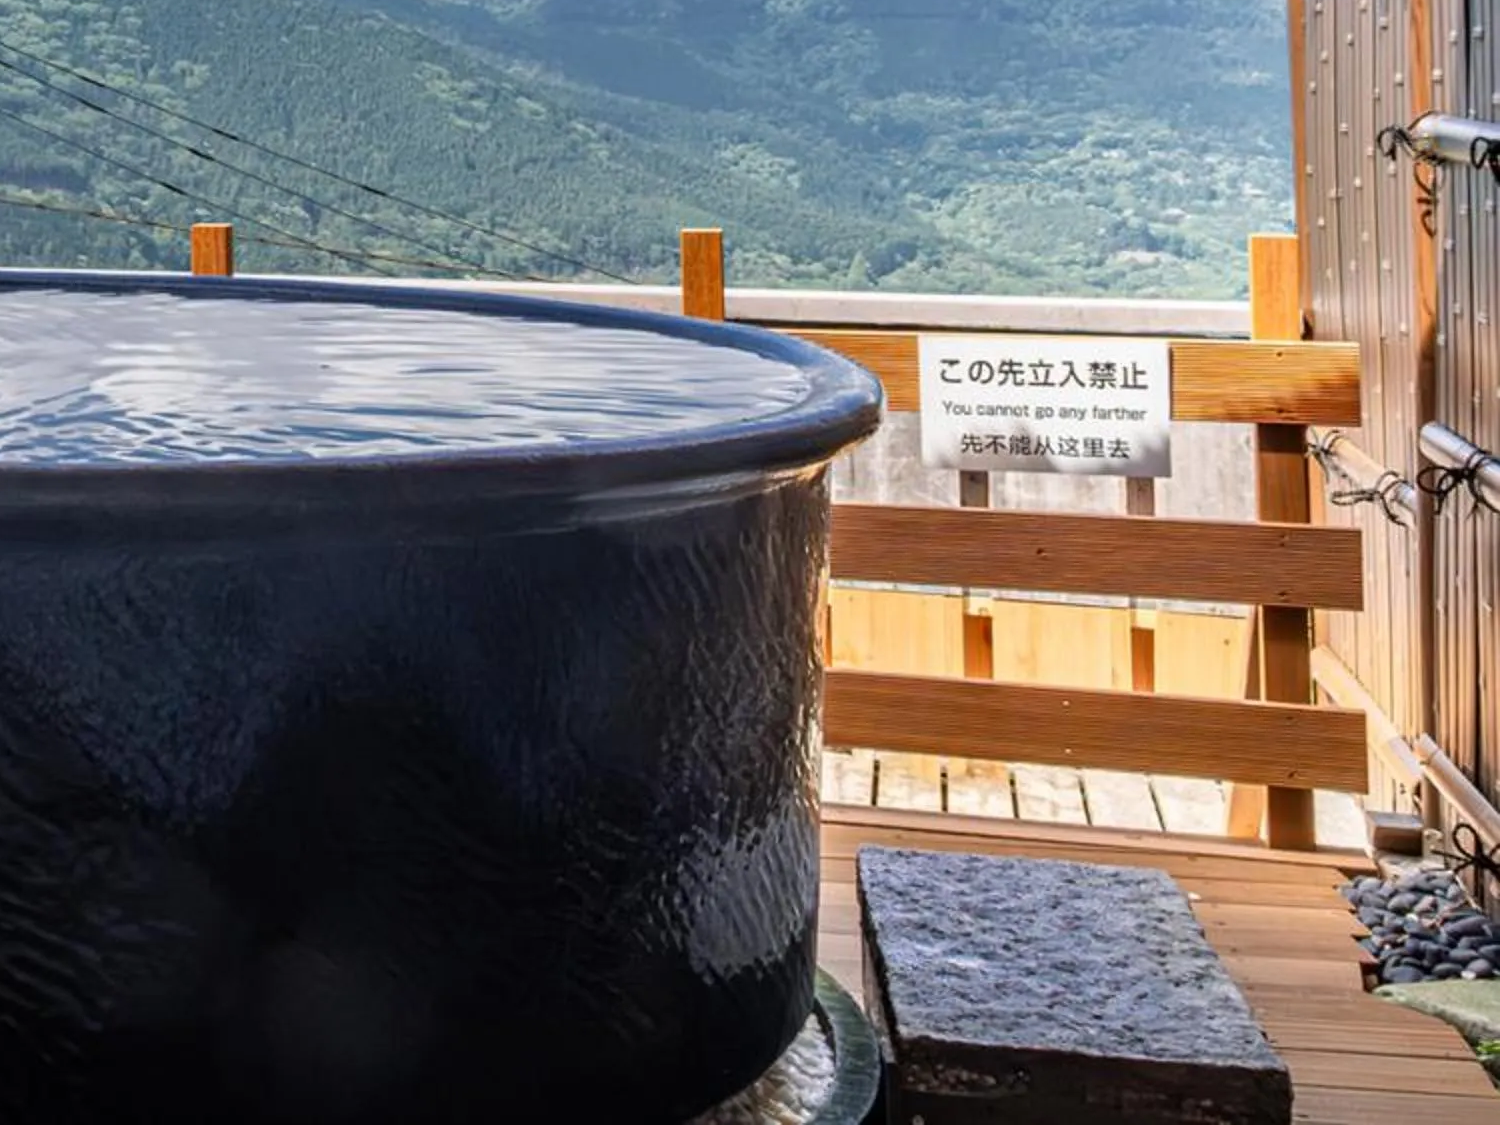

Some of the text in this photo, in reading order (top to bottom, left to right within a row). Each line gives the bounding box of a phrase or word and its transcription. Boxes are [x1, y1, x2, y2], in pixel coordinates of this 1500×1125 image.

[939, 358, 1149, 390] この先立入禁止
[942, 400, 972, 416] You
[976, 404, 1029, 418] cannot
[1035, 406, 1054, 420] go
[1059, 407, 1086, 421] any
[960, 433, 1131, 460] 先不能从这里去
